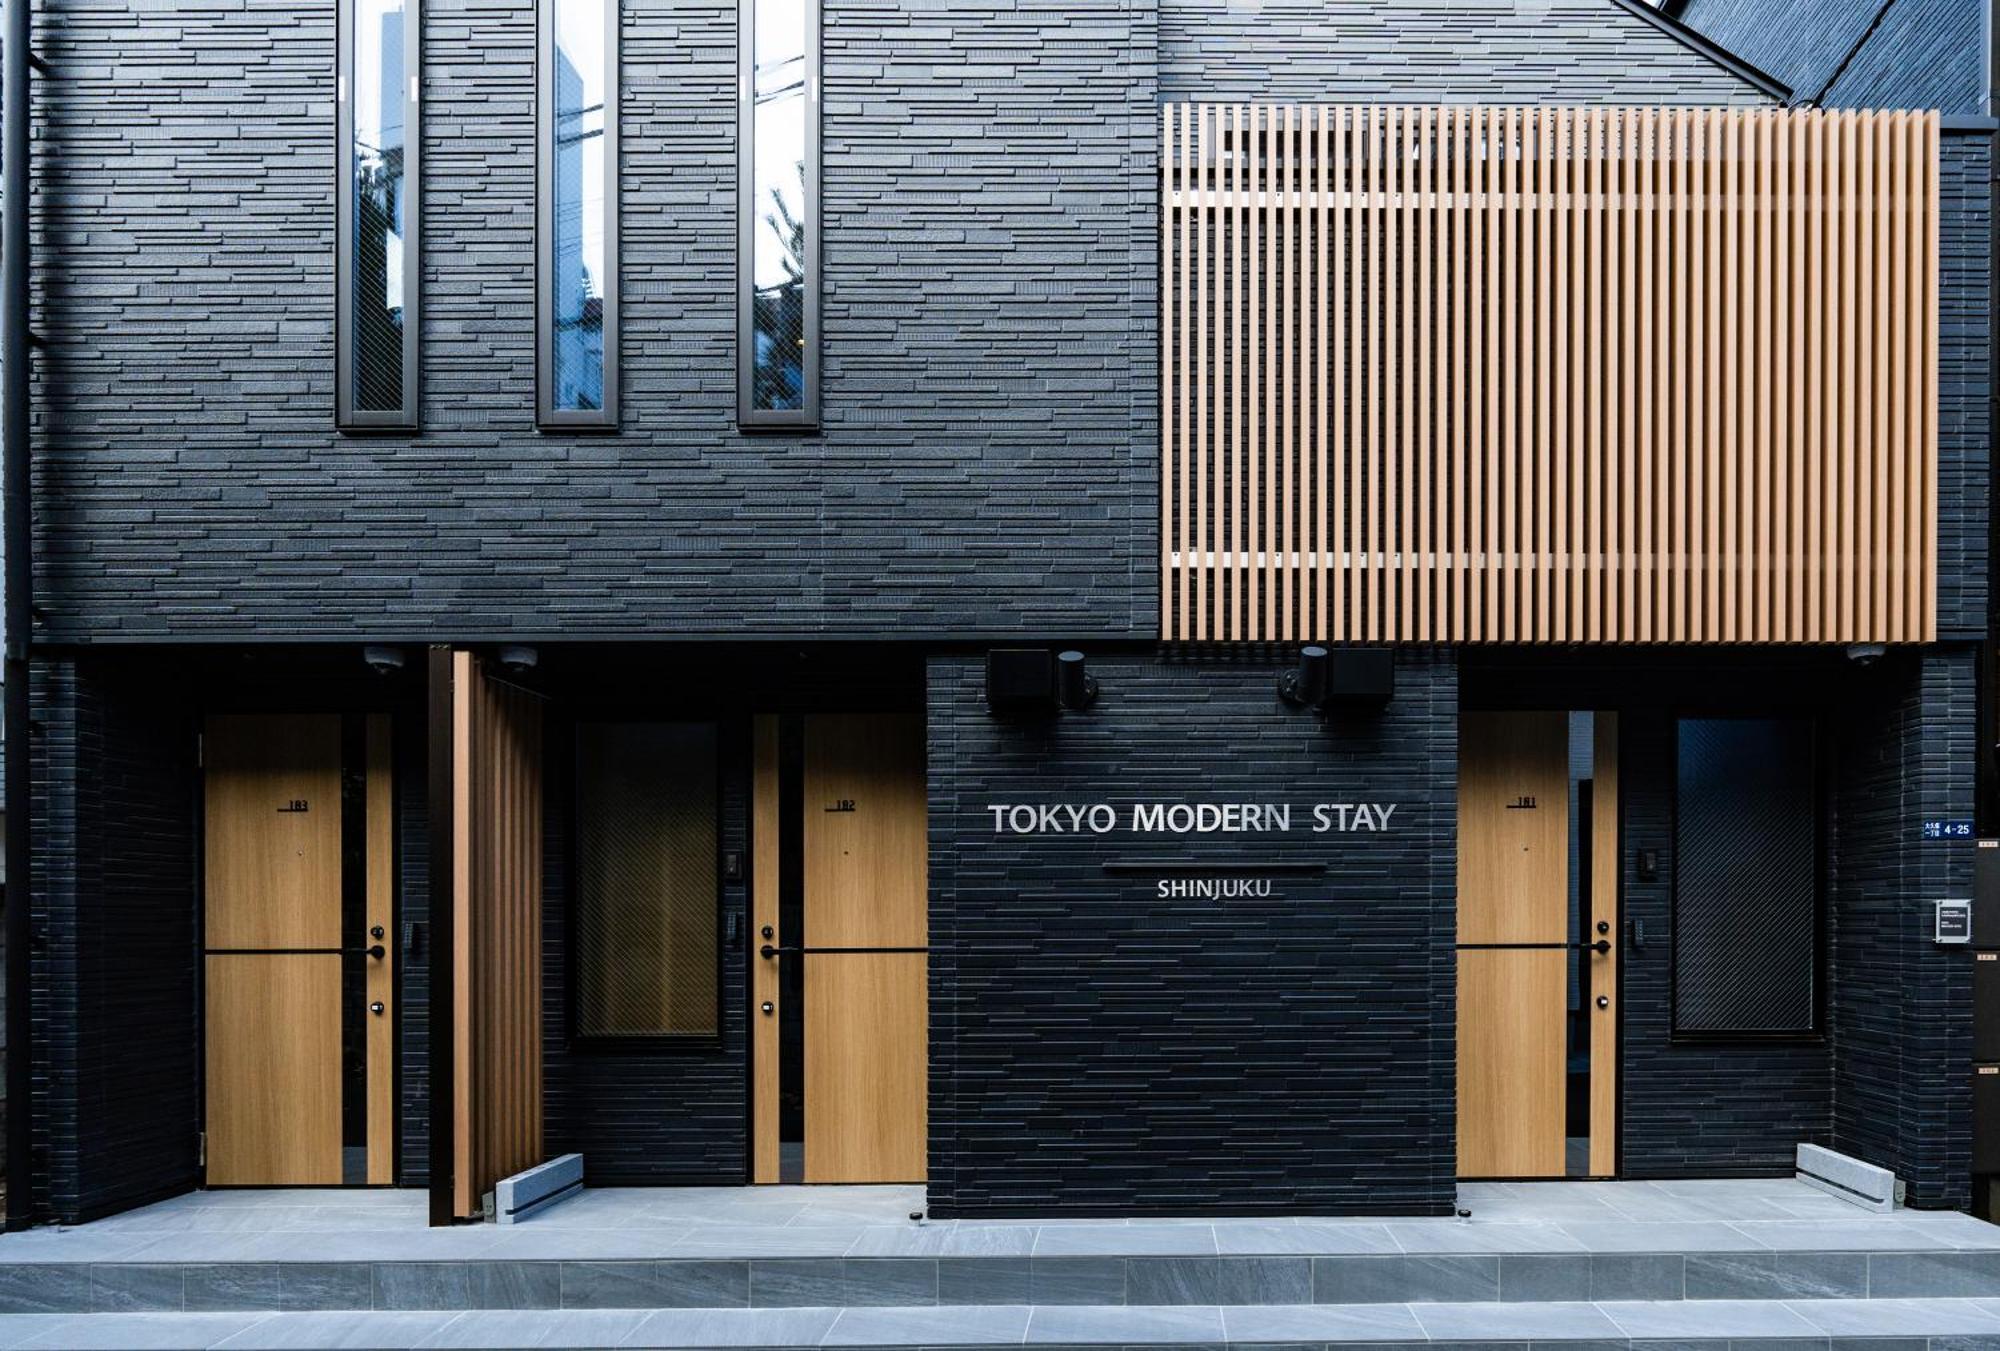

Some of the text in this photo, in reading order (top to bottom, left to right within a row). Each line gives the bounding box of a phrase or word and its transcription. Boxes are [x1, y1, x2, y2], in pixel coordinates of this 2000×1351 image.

[988, 804, 1397, 833] TOKYO MODERN STAY
[1944, 824, 1970, 835] 4-25
[1157, 879, 1272, 900] SHINJUKU
